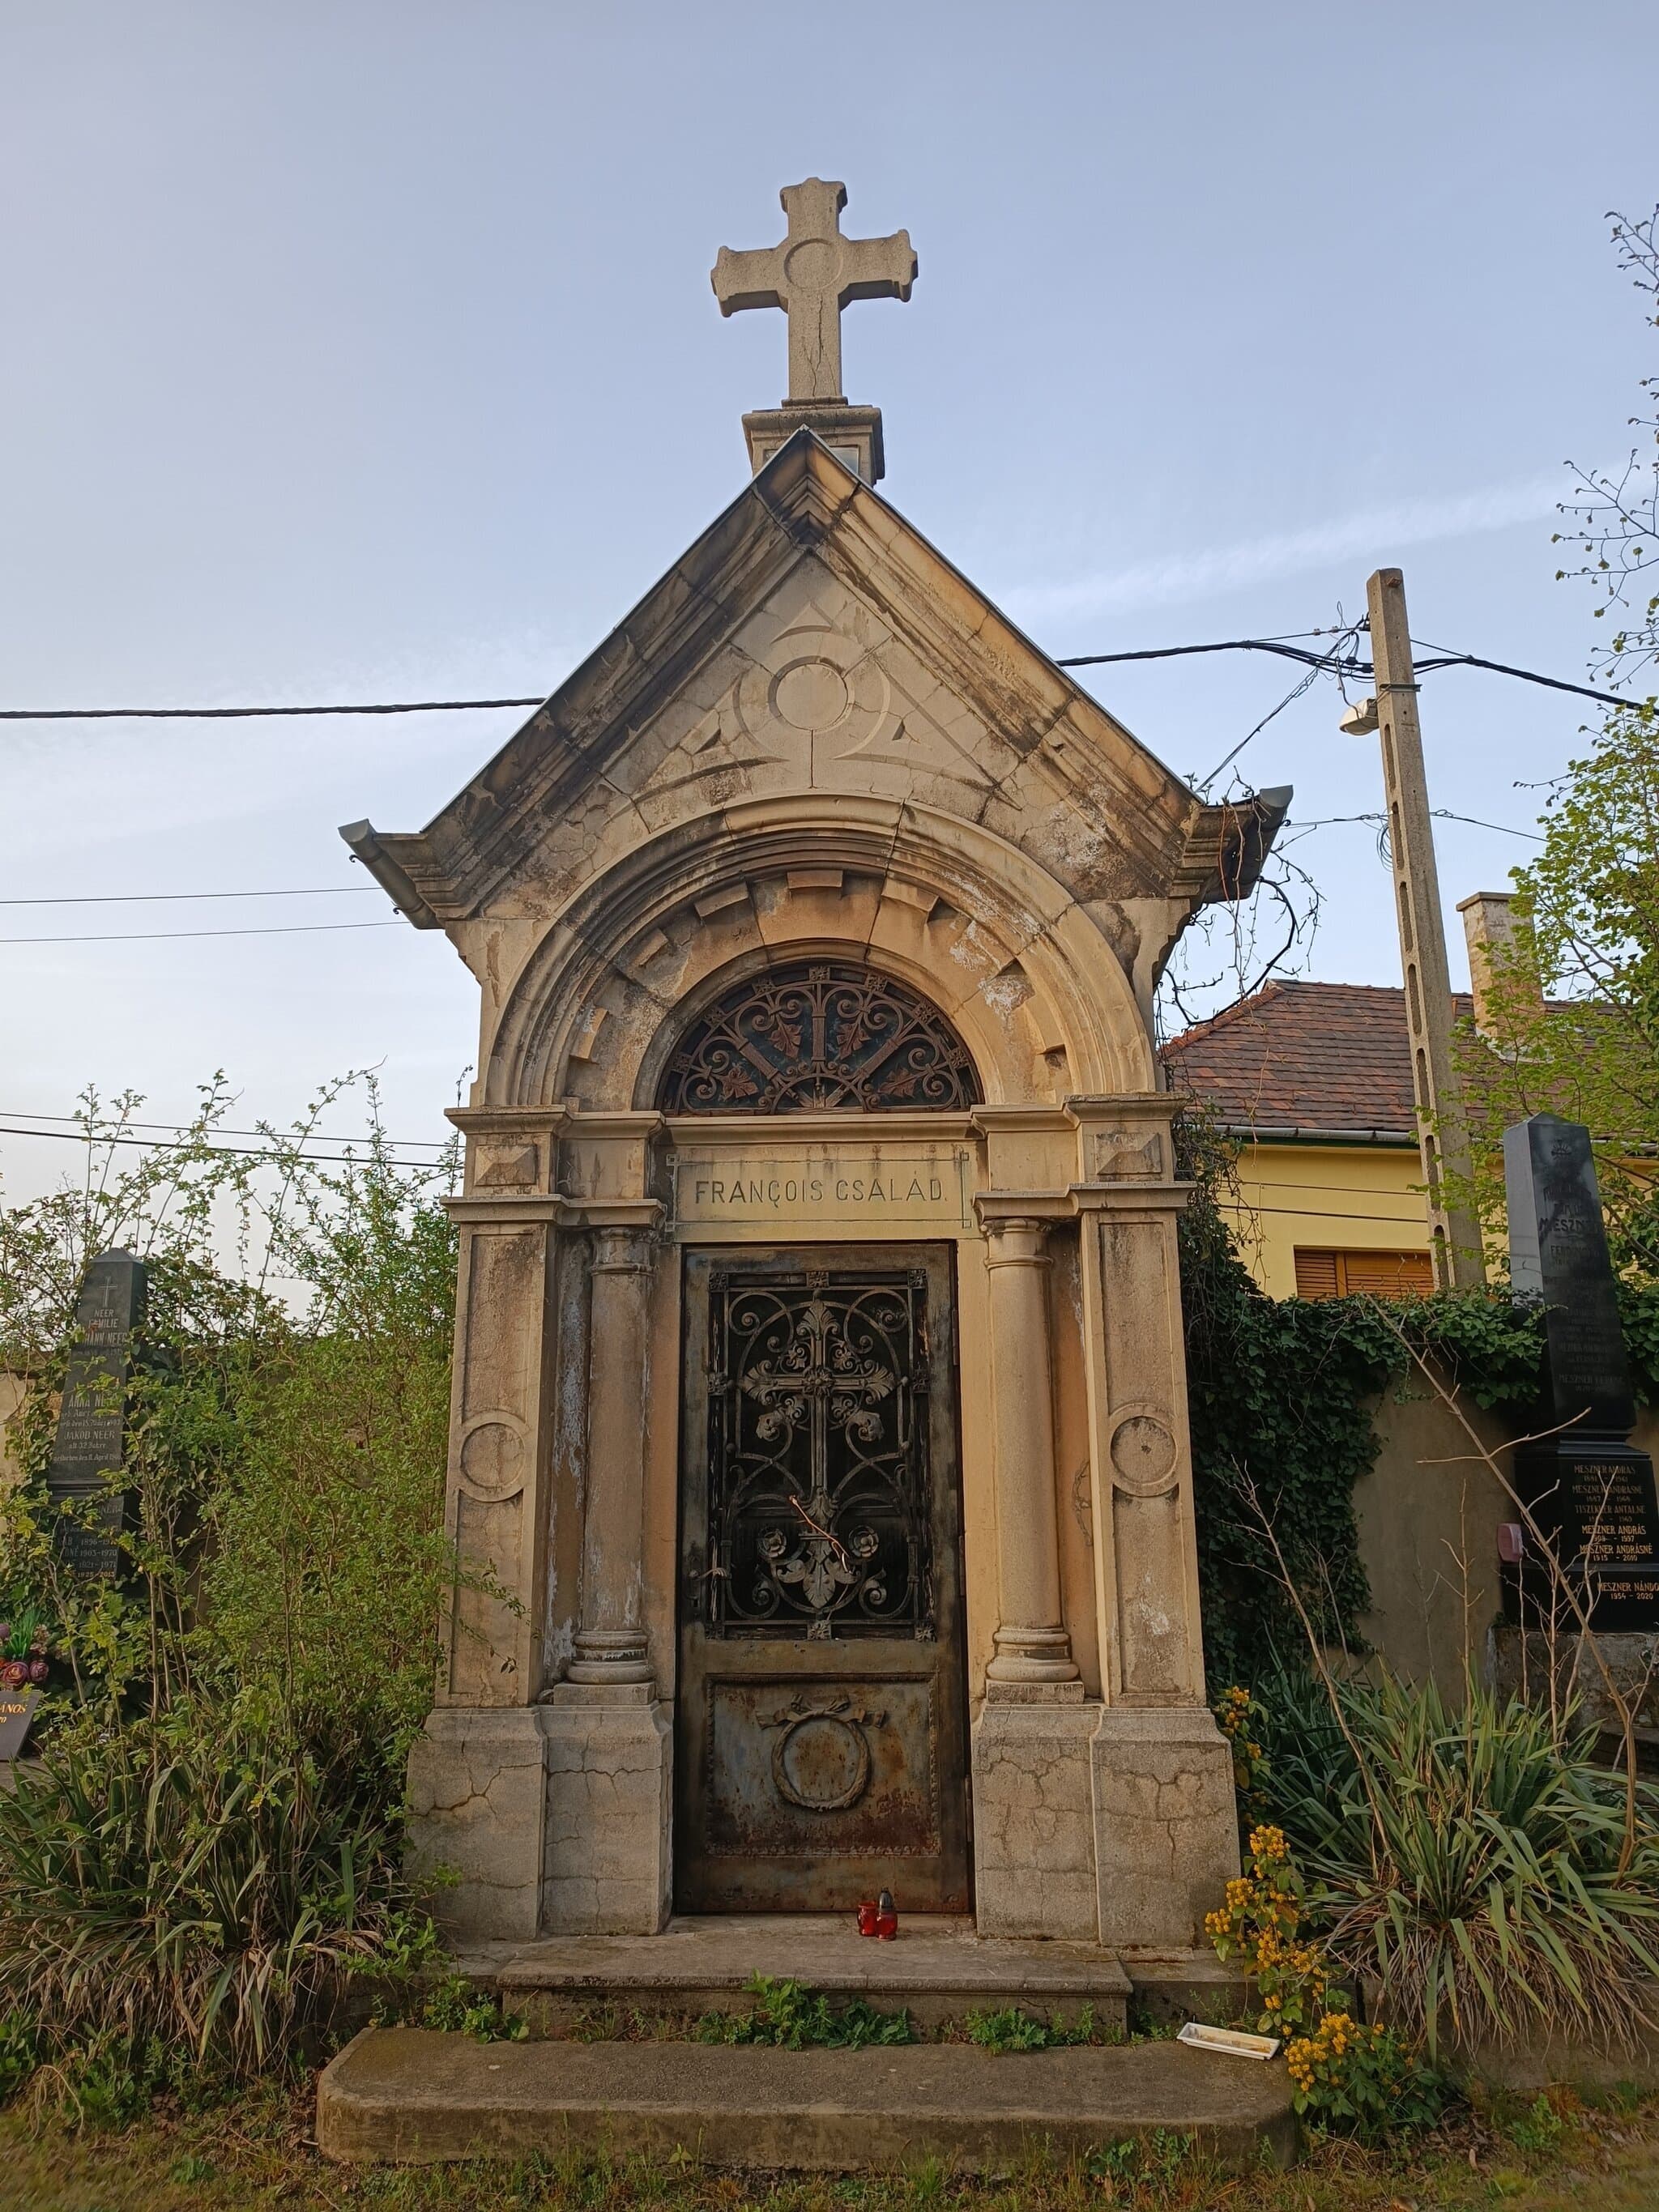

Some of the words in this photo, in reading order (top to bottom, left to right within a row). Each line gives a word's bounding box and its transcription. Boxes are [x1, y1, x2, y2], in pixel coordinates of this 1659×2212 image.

[695, 1179, 824, 1208] FRANÇOIS
[95, 1309, 114, 1318] NEER
[93, 1430, 115, 1439] NEER
[1618, 1524, 1647, 1535] ANDRÁS
[1616, 1543, 1653, 1554] ANDRÁSNÉ
